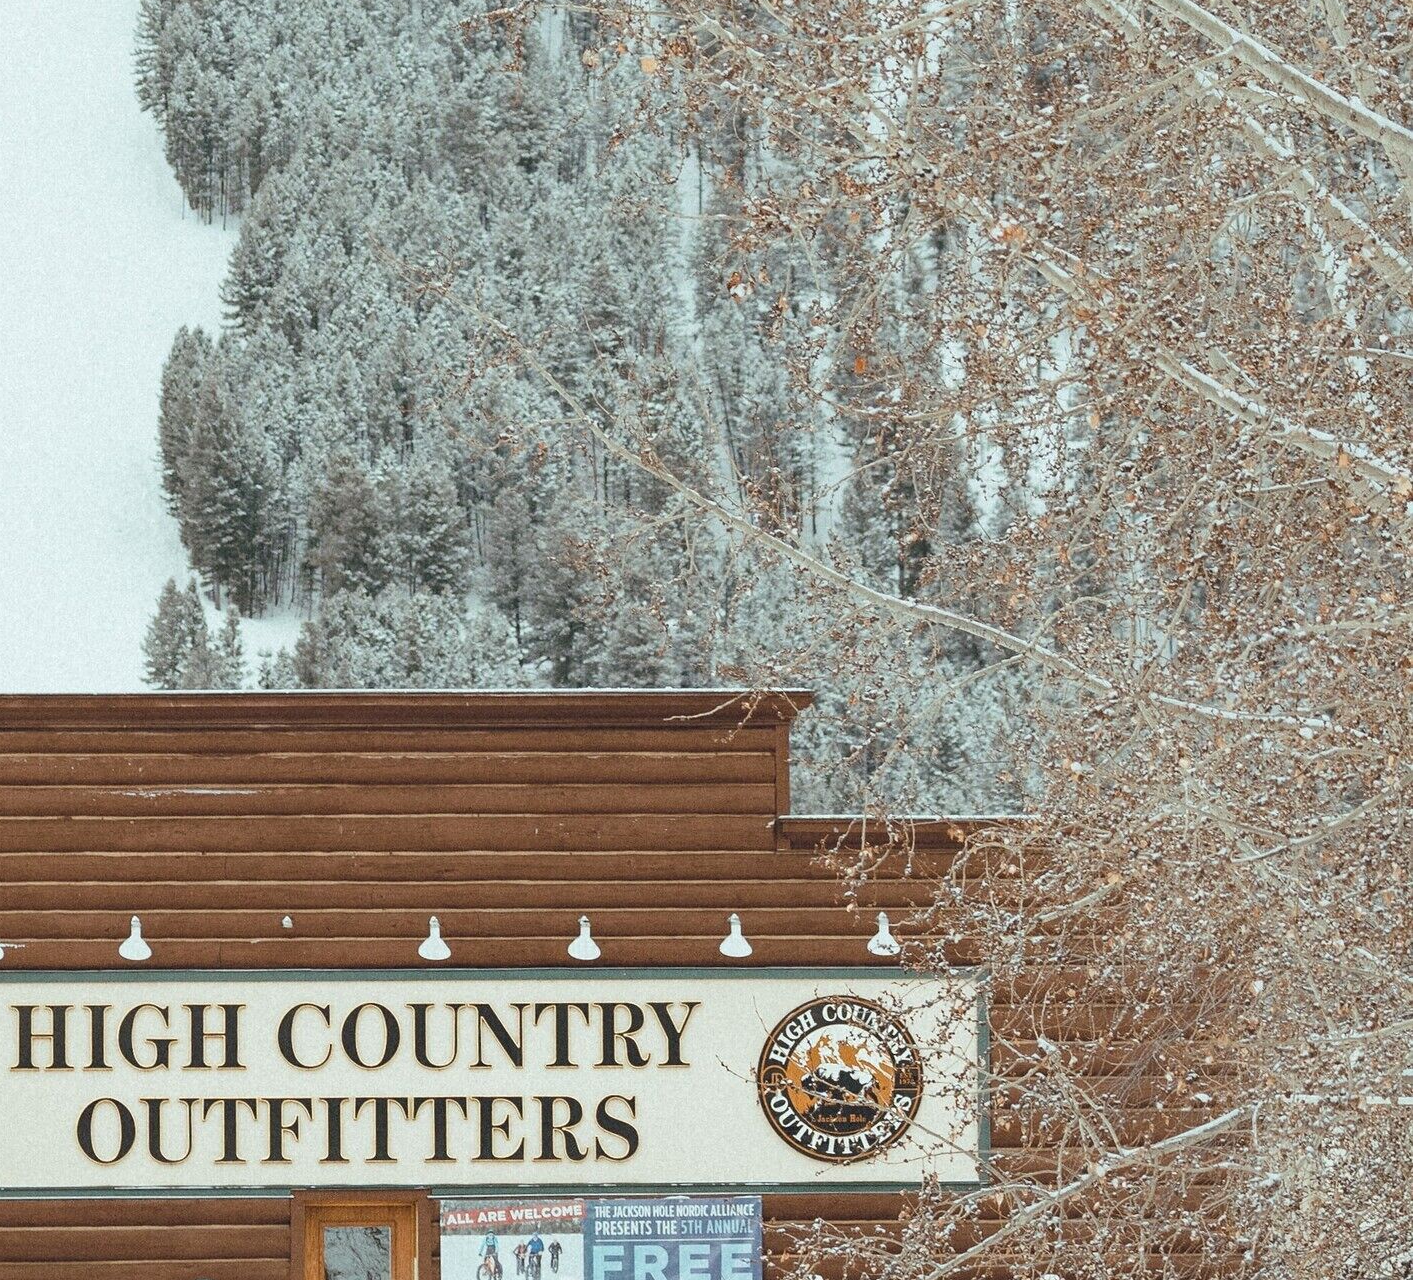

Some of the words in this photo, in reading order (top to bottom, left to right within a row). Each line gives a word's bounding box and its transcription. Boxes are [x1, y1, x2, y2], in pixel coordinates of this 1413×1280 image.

[9, 1003, 247, 1071] HIGH
[276, 1000, 701, 1071] COUNTRY
[768, 1009, 818, 1066] HIGH
[75, 1096, 641, 1166] OUTFITTERS
[769, 1093, 913, 1155] OUTFITTERS
[446, 1213, 474, 1225] ALL
[477, 1210, 507, 1222] ARE
[509, 1204, 583, 1220] WELCOME
[594, 1206, 611, 1218] THE
[612, 1205, 652, 1218] JACKSON
[653, 1205, 674, 1218] HOLE
[676, 1204, 708, 1217] NORDIC
[710, 1203, 755, 1216] ALLIANCE
[594, 1221, 653, 1235] PRESENTS
[655, 1220, 678, 1235] THE
[681, 1220, 703, 1234] 5TH
[706, 1219, 754, 1234] ANNUAL
